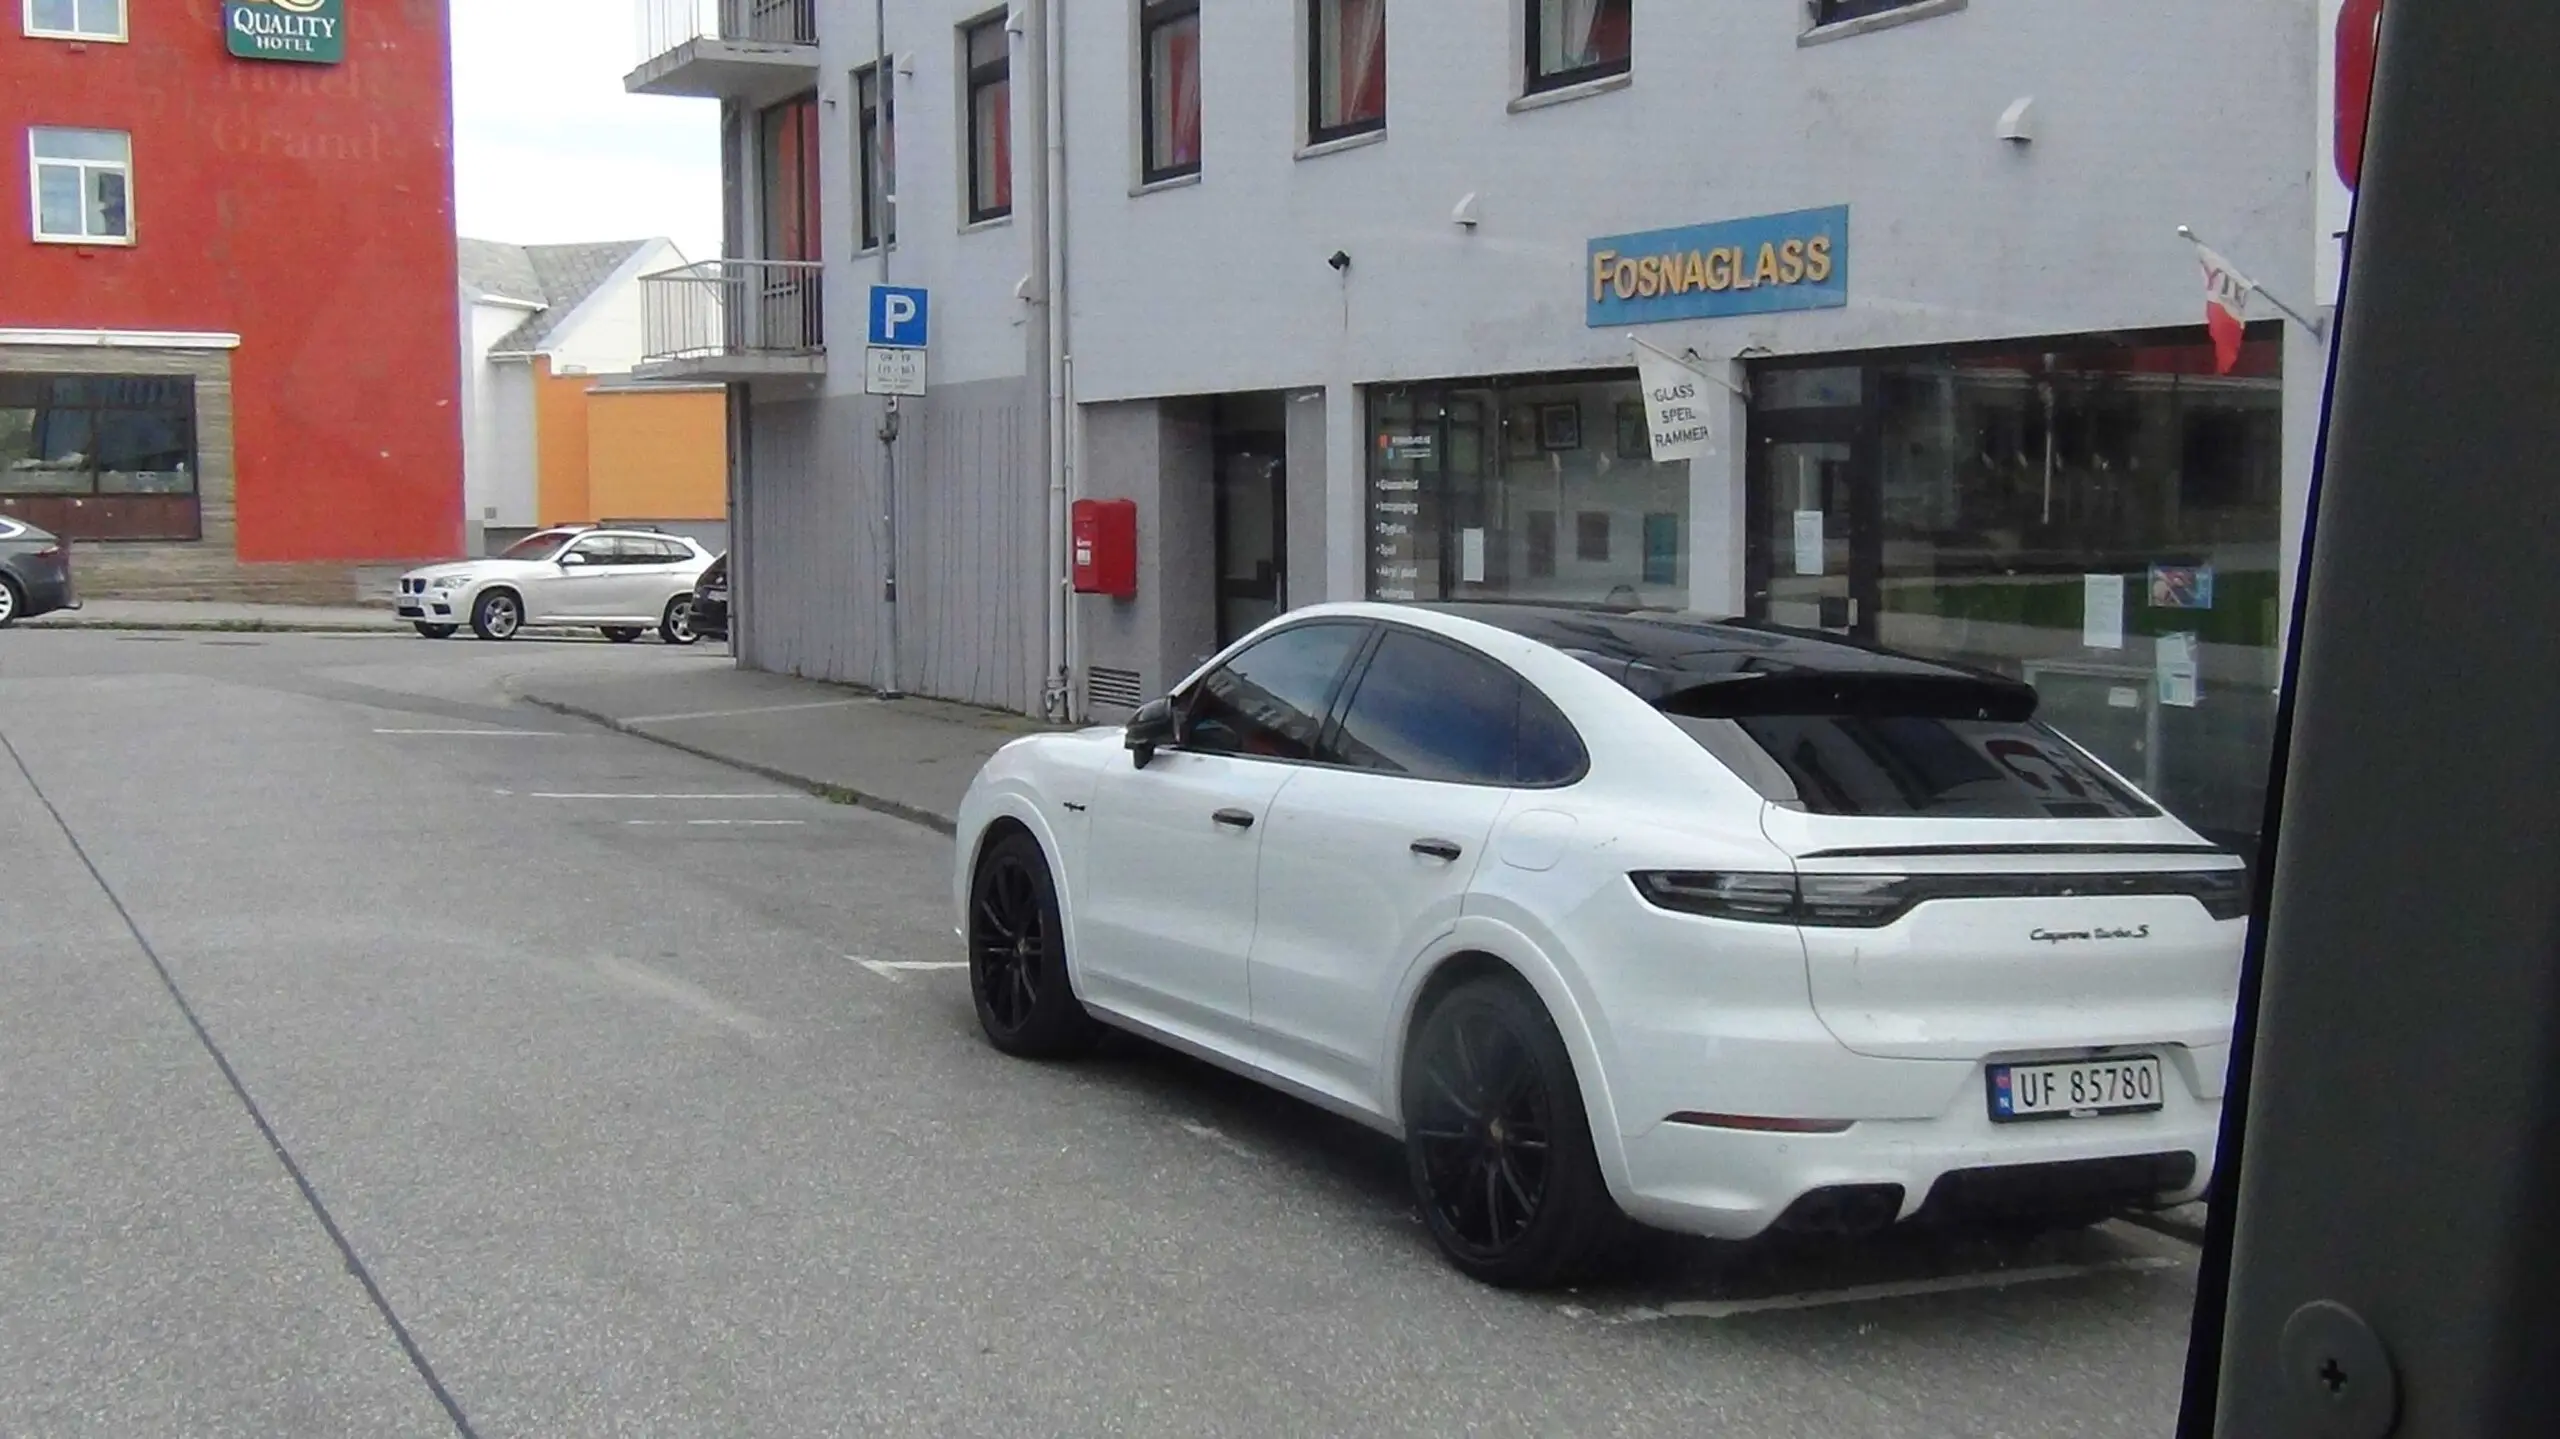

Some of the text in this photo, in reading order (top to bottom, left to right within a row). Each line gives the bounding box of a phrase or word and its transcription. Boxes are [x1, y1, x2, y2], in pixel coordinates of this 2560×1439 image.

[233, 7, 336, 38] QUALITY
[256, 36, 315, 51] HOTEL
[1593, 235, 1831, 303] FOSNAGLASS
[885, 294, 916, 339] P
[1654, 383, 1696, 402] GLASS
[1661, 407, 1697, 424] SPEIL
[1654, 425, 1710, 448] RAMMER
[2021, 1066, 2152, 1108] UF 85780
